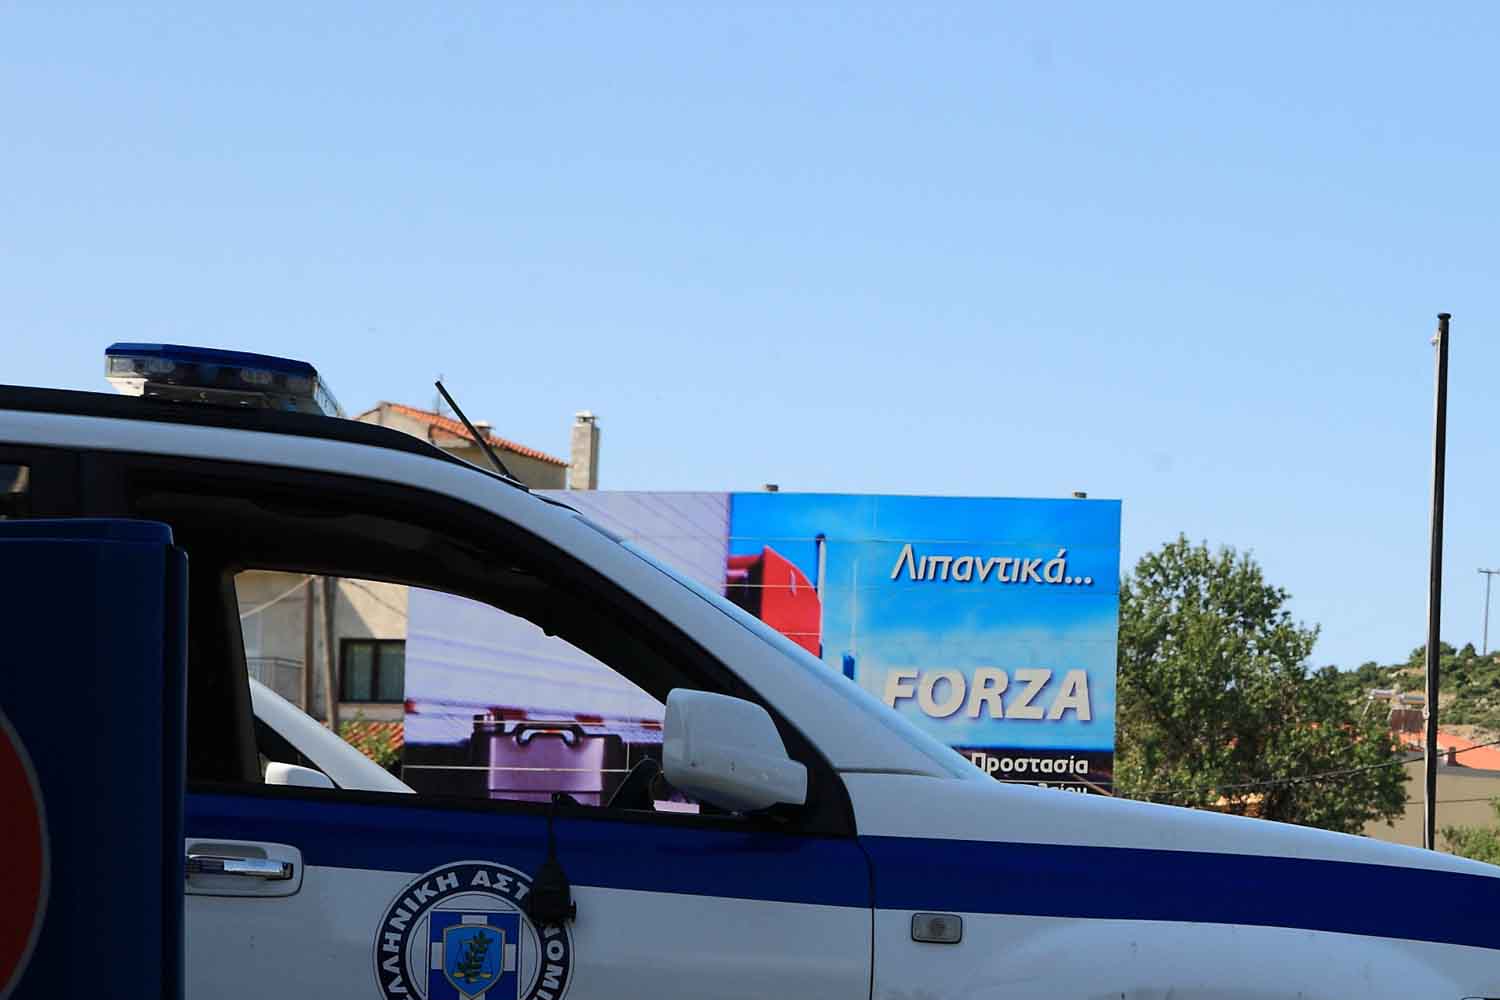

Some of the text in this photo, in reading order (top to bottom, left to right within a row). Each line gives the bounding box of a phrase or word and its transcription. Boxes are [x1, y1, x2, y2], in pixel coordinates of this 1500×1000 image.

[891, 544, 1092, 585] Λιπαντικά...
[886, 666, 1091, 721] FORZA
[971, 753, 1089, 778] Προστασία
